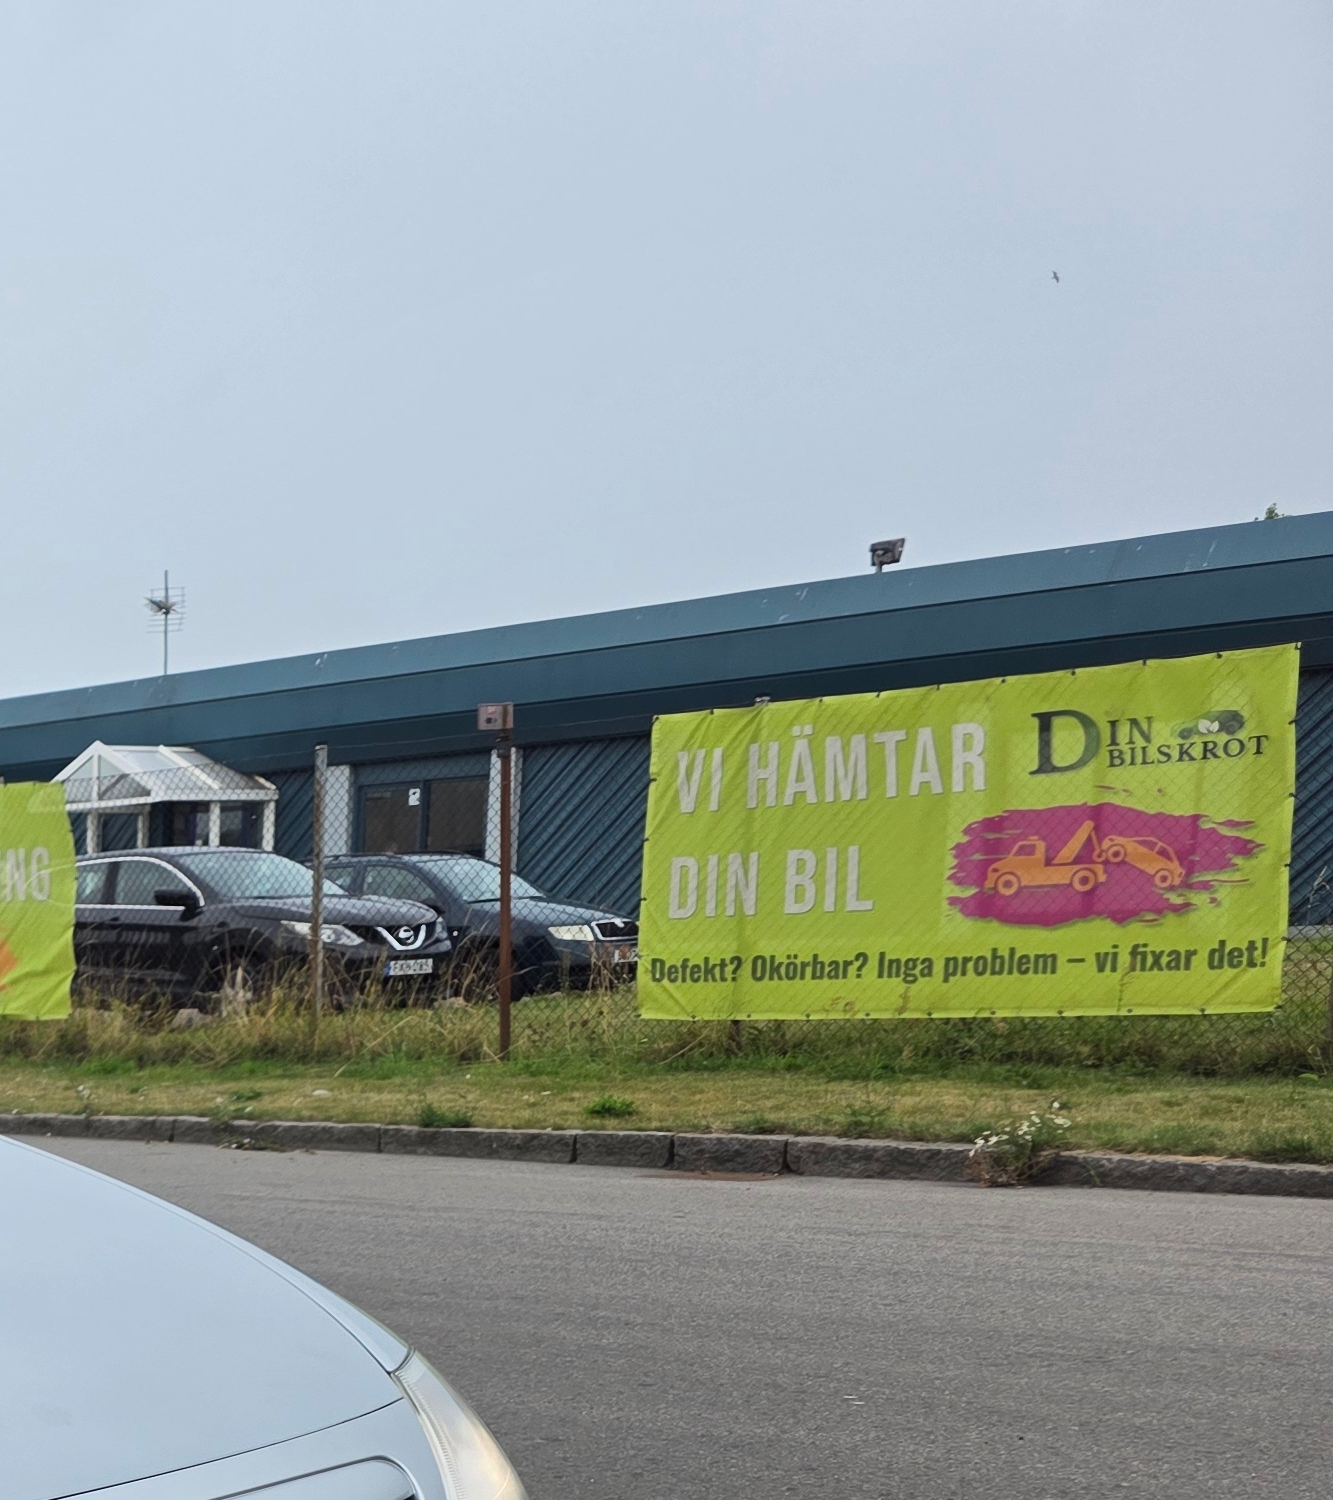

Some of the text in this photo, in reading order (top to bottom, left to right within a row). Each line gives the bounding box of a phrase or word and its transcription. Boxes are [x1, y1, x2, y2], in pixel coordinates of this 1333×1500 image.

[677, 722, 987, 814] VI HÄMTAR
[1028, 709, 1153, 776] DIN
[1106, 734, 1269, 769] BILSKROT
[668, 845, 874, 919] DIN BIL
[650, 955, 743, 984] Defekt?
[750, 951, 869, 982] Okörbar?
[877, 951, 934, 985] Inga
[942, 946, 1058, 984] problem
[1095, 943, 1120, 973] vi
[1129, 943, 1198, 973] fixar
[1207, 937, 1270, 971] det!
